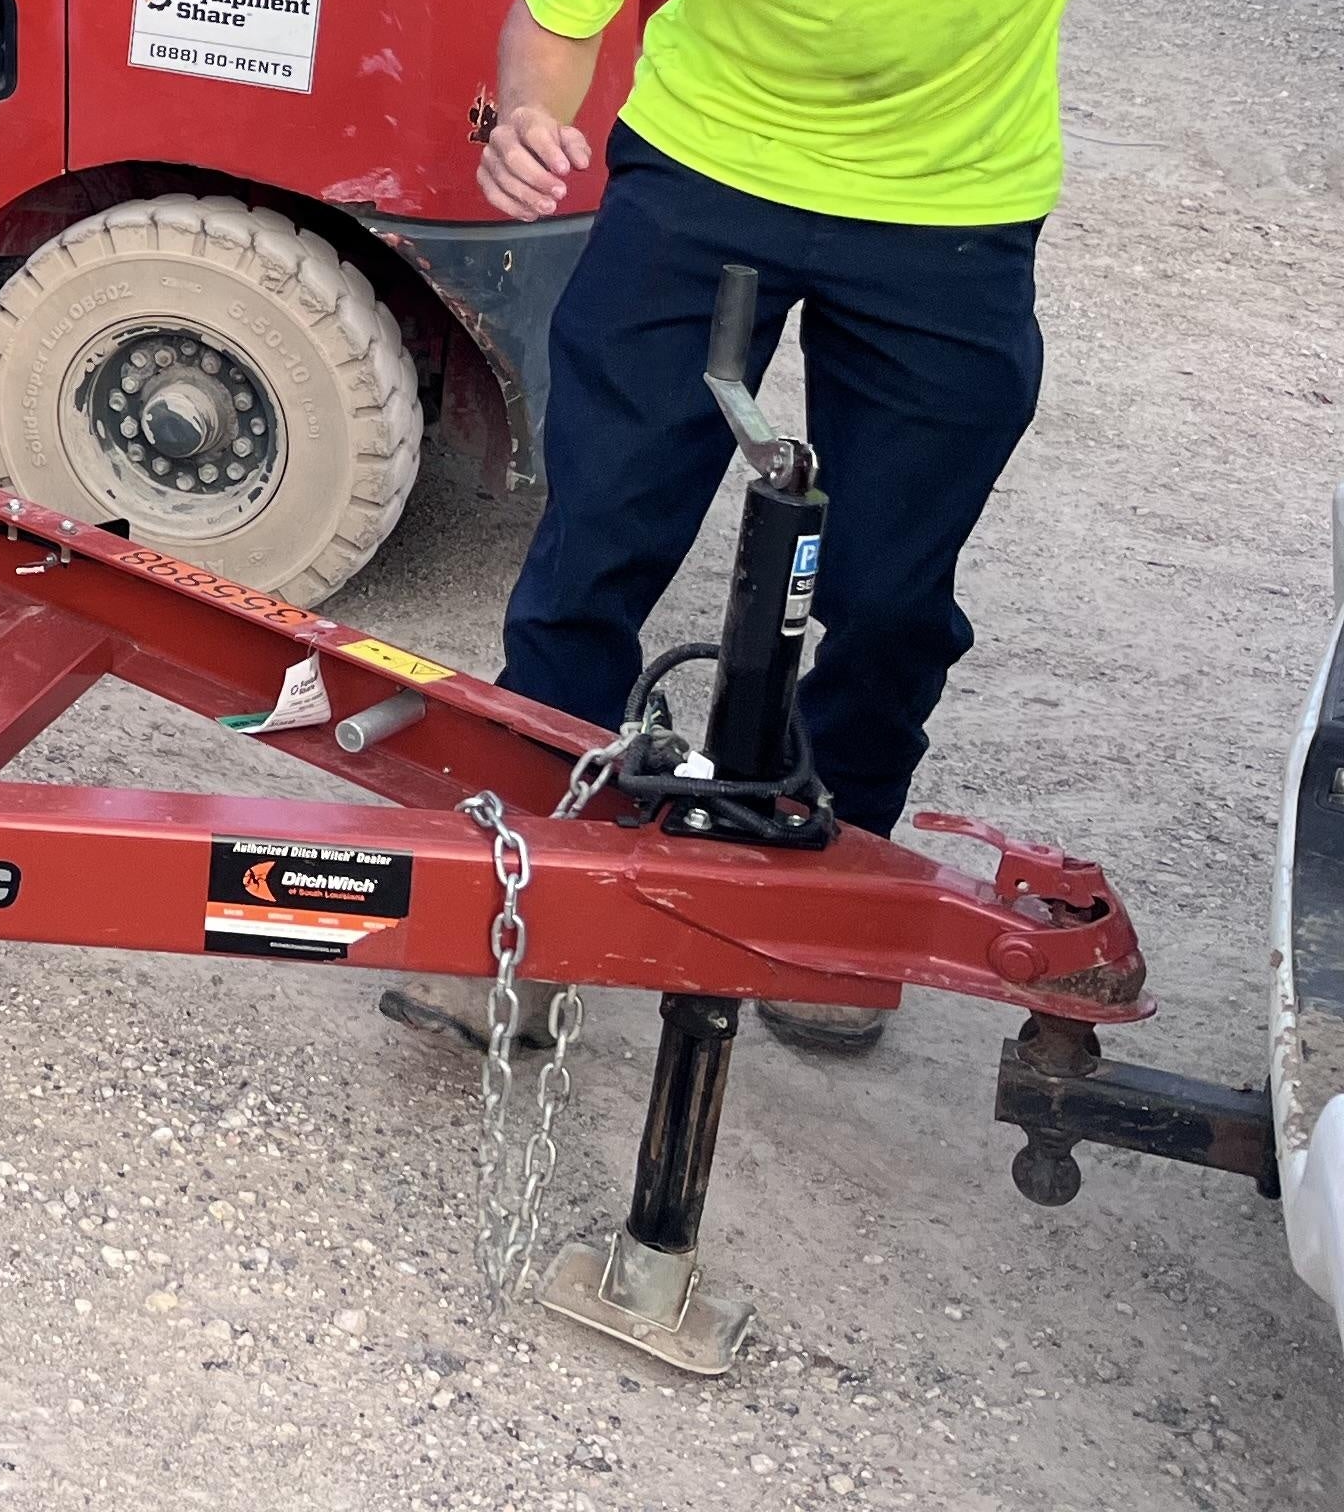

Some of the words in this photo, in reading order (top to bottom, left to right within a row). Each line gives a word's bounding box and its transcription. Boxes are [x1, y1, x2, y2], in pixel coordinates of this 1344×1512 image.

[176, 1, 246, 28] Share
[149, 43, 198, 64] (888)
[204, 53, 292, 78] 80-RENTS
[120, 551, 309, 624] 355898
[232, 841, 290, 858] Authorized
[291, 847, 318, 859] Ditch
[356, 852, 392, 866] Dealer
